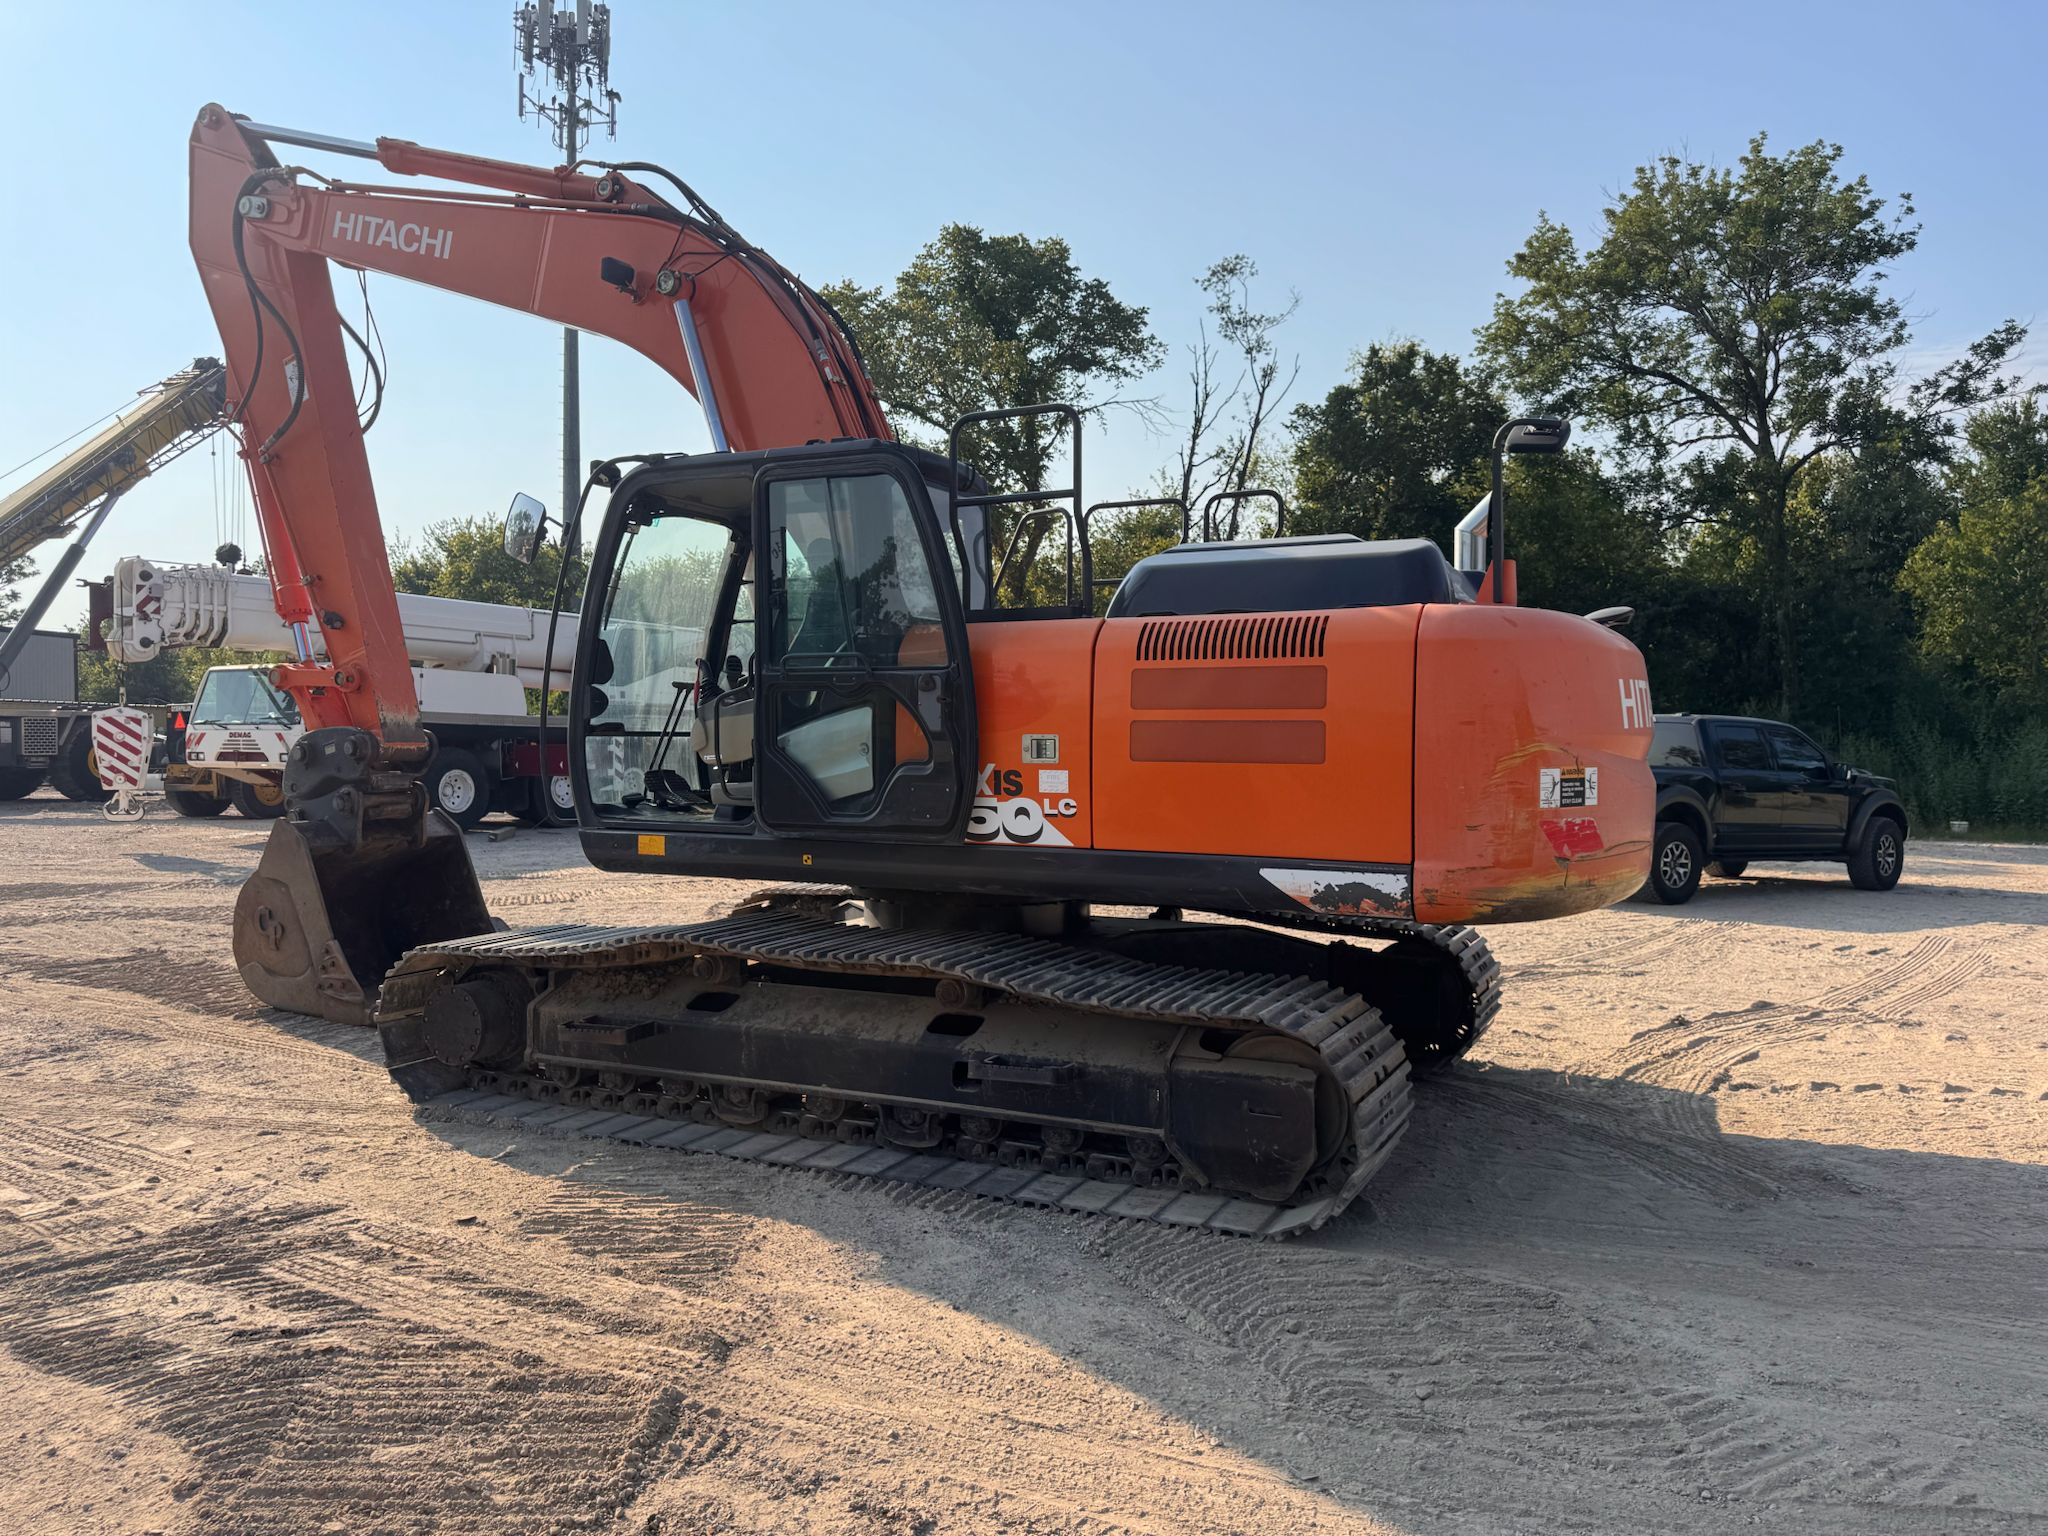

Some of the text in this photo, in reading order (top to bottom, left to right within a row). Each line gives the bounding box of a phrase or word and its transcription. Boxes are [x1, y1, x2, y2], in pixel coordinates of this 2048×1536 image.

[332, 210, 454, 260] HITACHI
[1618, 678, 1652, 729] HIT
[976, 763, 1024, 797] XIS
[965, 797, 1077, 844] 50 LC
